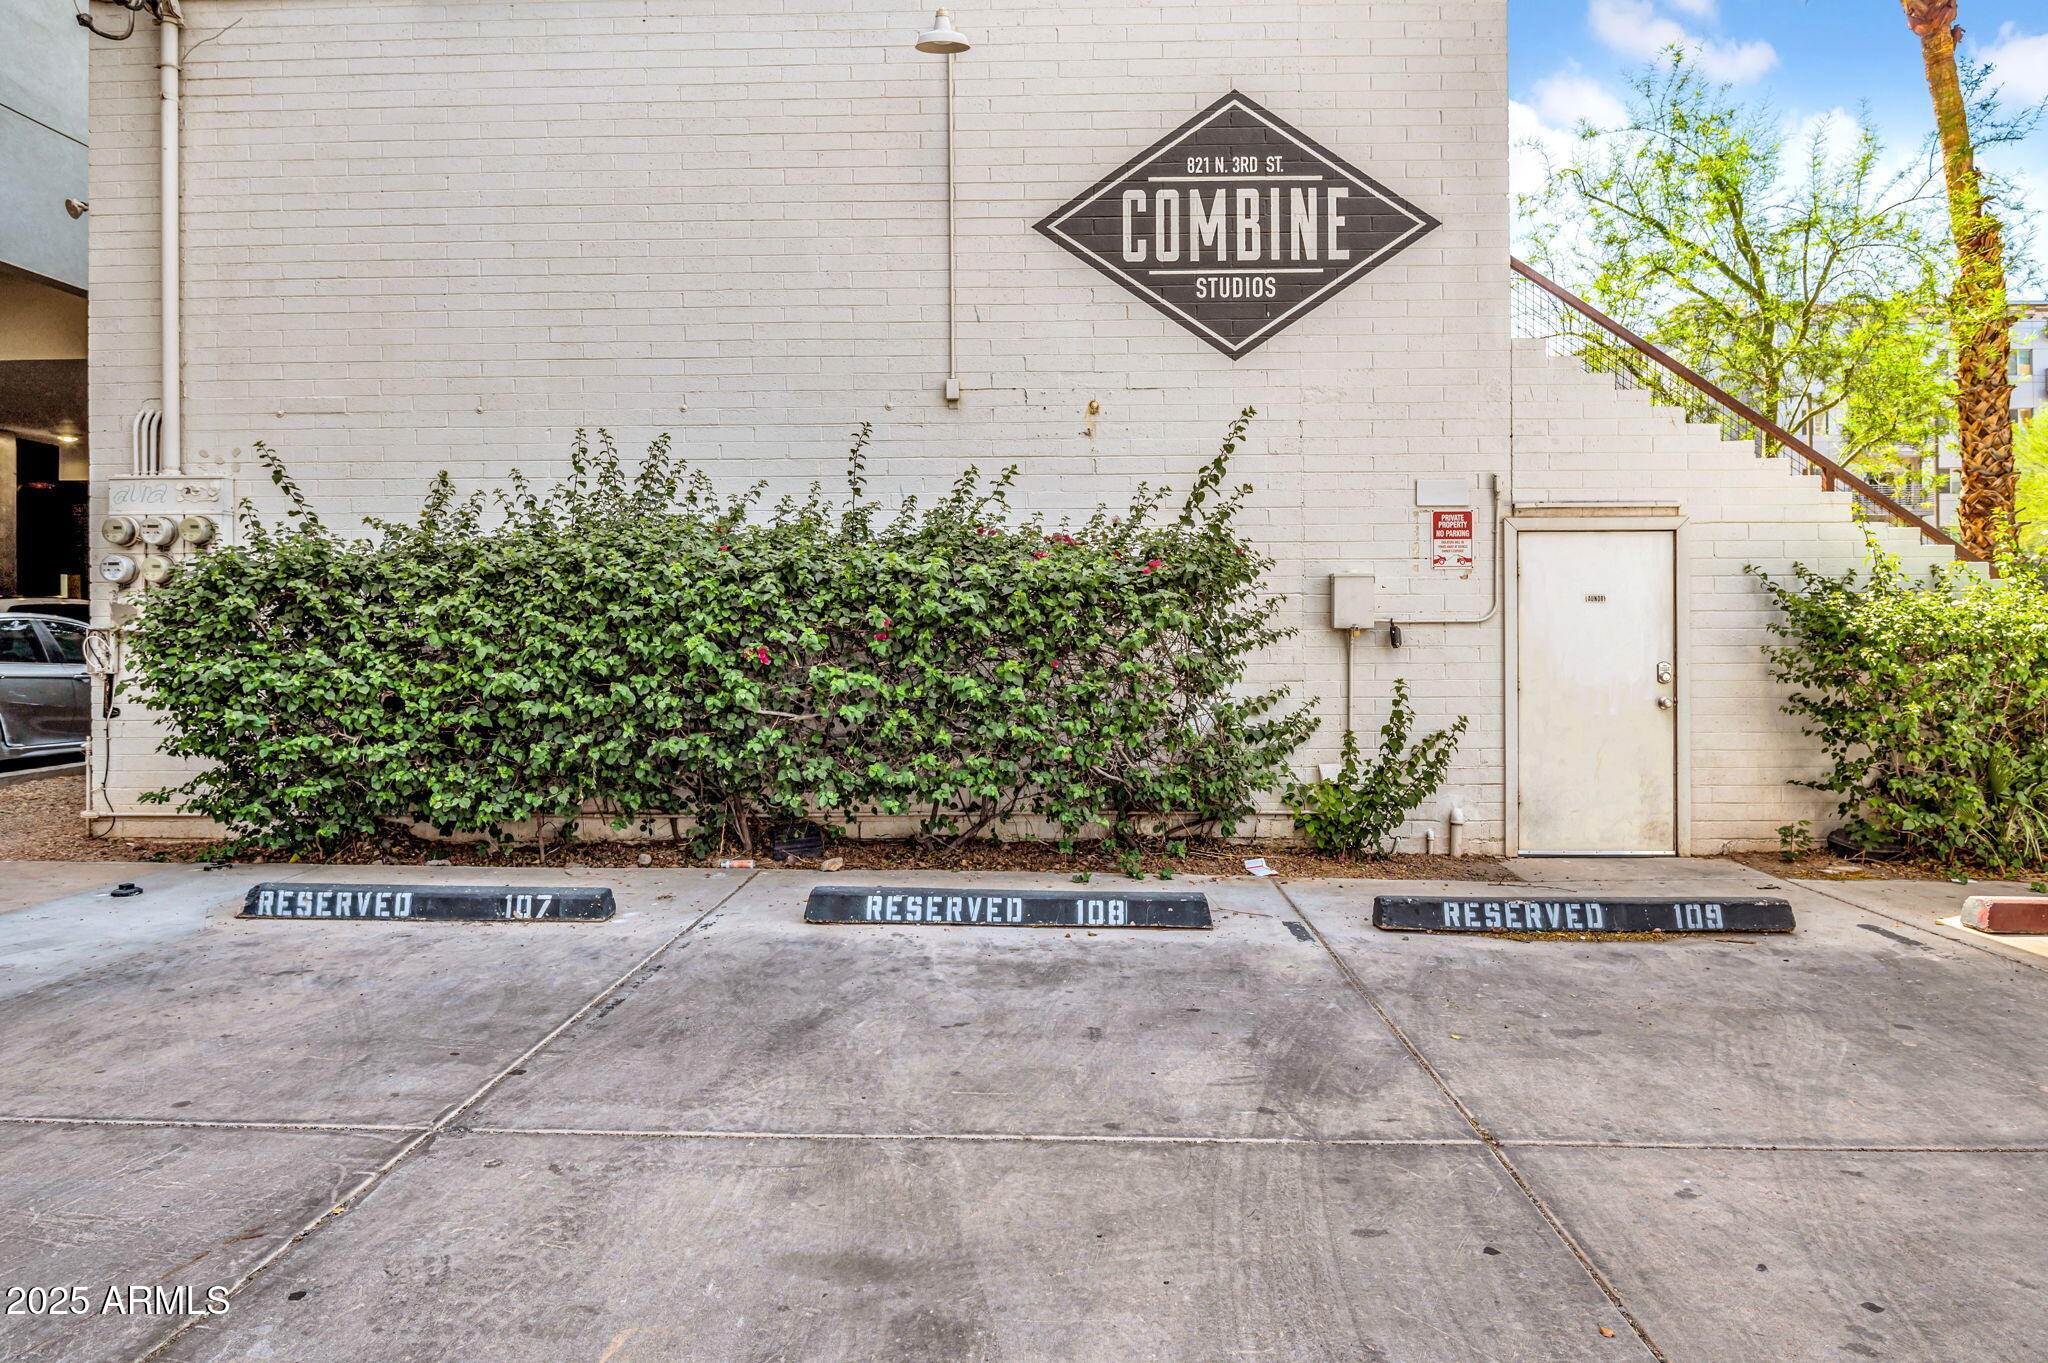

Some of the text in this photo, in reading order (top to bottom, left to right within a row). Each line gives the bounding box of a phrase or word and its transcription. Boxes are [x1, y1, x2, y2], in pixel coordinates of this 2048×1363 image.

[1187, 156, 1284, 174] 821 N. 3RD ST.
[1122, 187, 1350, 262] COMBINE
[1196, 277, 1276, 298] STUDIOS
[257, 890, 552, 919] RESERVED 107
[866, 895, 1126, 925] RESERVED 108
[1443, 902, 1723, 929] RESERVED 109
